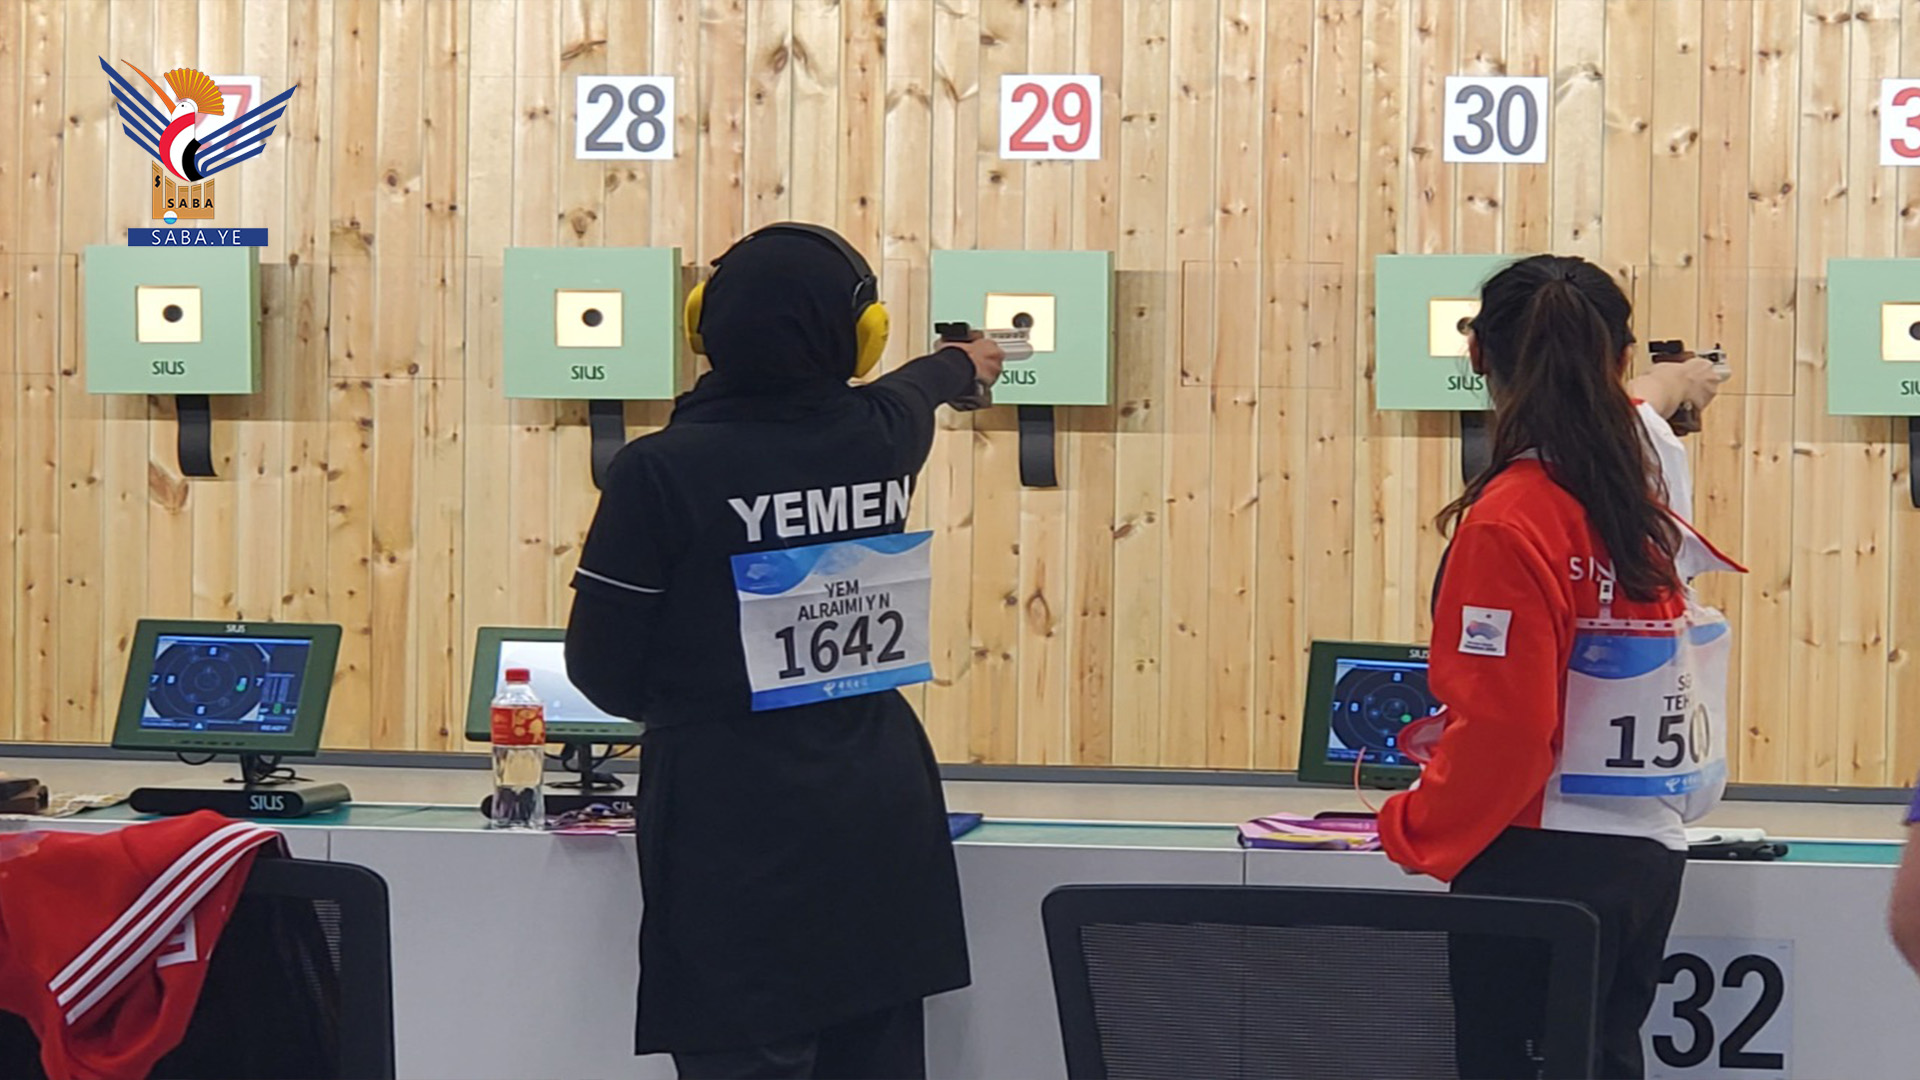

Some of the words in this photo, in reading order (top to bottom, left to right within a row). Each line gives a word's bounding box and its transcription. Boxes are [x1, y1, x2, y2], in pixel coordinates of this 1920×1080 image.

[584, 83, 666, 152] 28
[1009, 82, 1092, 152] 29
[1453, 84, 1539, 156] 30
[152, 360, 186, 375] SIUS
[571, 365, 605, 380] SIUS
[1001, 369, 1037, 385] SIUS
[1447, 375, 1484, 391] SIUS
[728, 474, 911, 542] YEMEN
[824, 579, 860, 598] YEM
[797, 597, 863, 622] ALRAIMI
[866, 594, 877, 611] Y
[879, 592, 890, 609] N
[774, 610, 906, 680] 1642
[249, 794, 285, 811] SIUS
[1651, 951, 1785, 1070] 32
